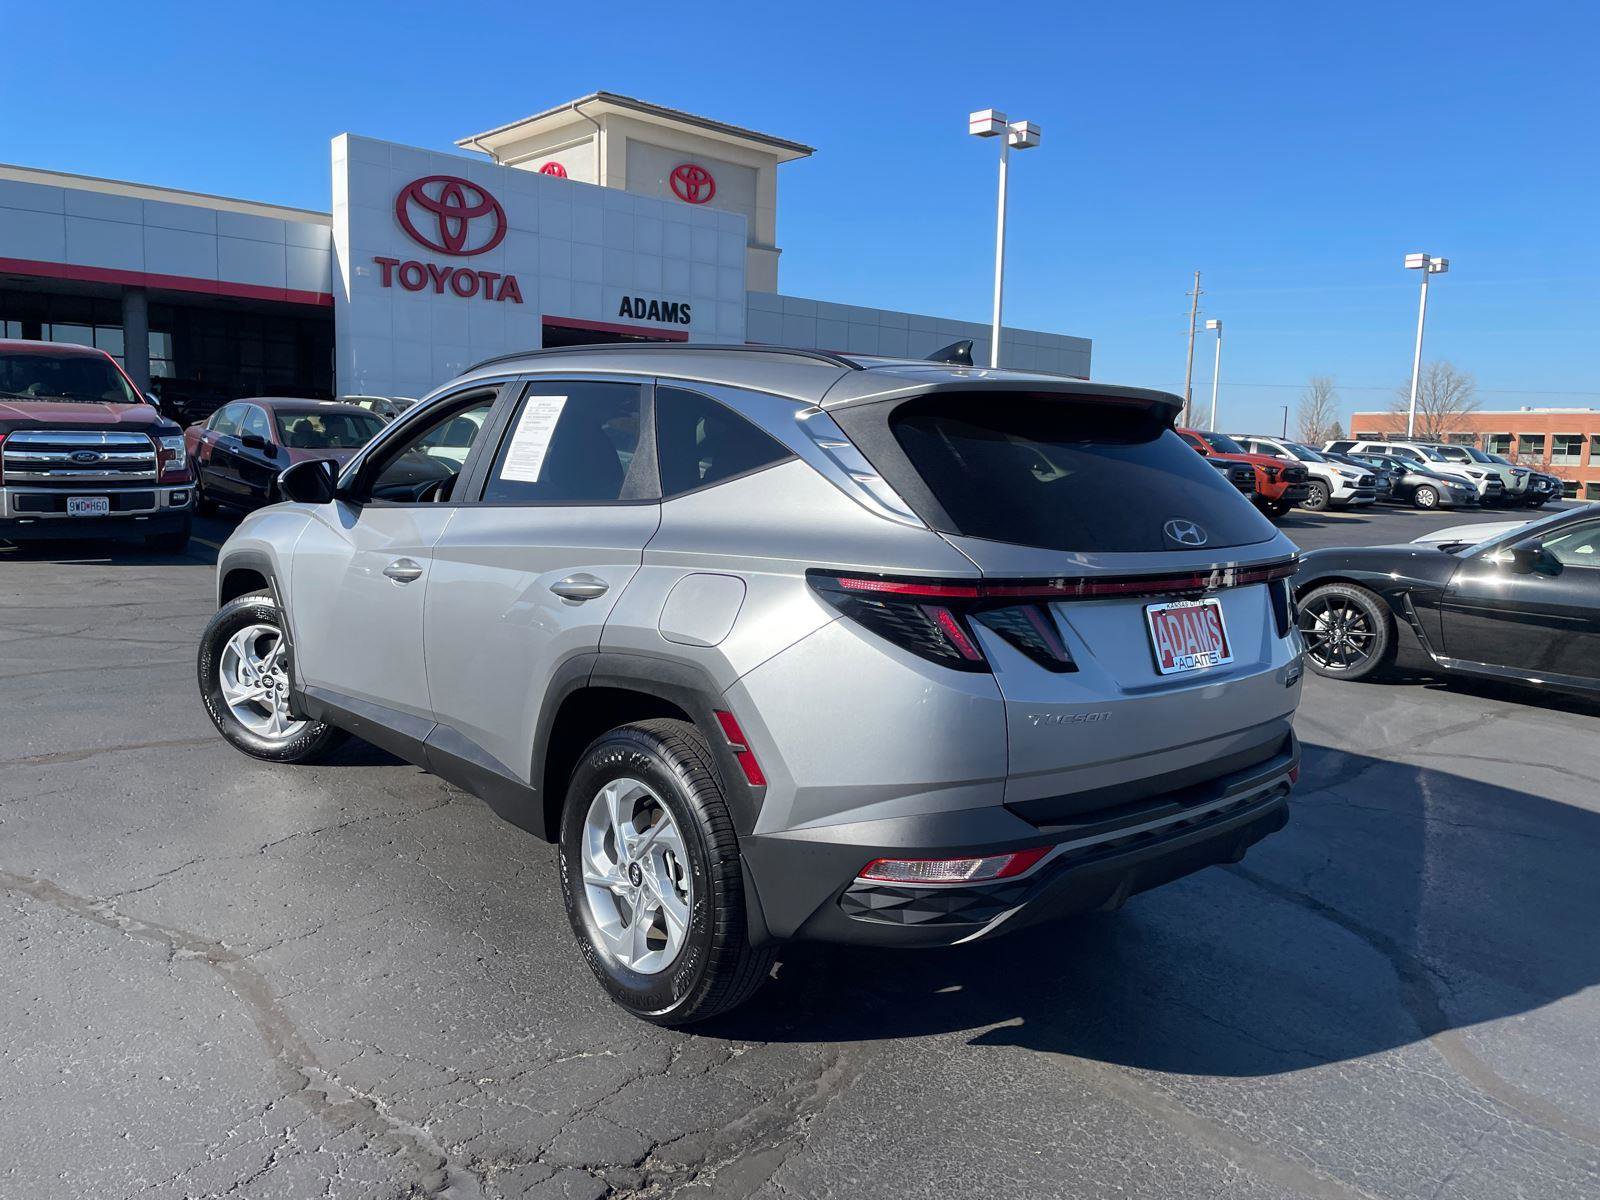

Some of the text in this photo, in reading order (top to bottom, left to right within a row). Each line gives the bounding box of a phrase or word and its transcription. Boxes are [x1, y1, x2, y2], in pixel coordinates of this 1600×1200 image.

[374, 256, 523, 304] TOYOTA
[619, 296, 691, 324] ADAMS
[77, 453, 95, 461] Ford
[1166, 601, 1188, 609] KANSAS
[1156, 610, 1224, 660] ADAMS
[1179, 653, 1219, 669] ADAMS
